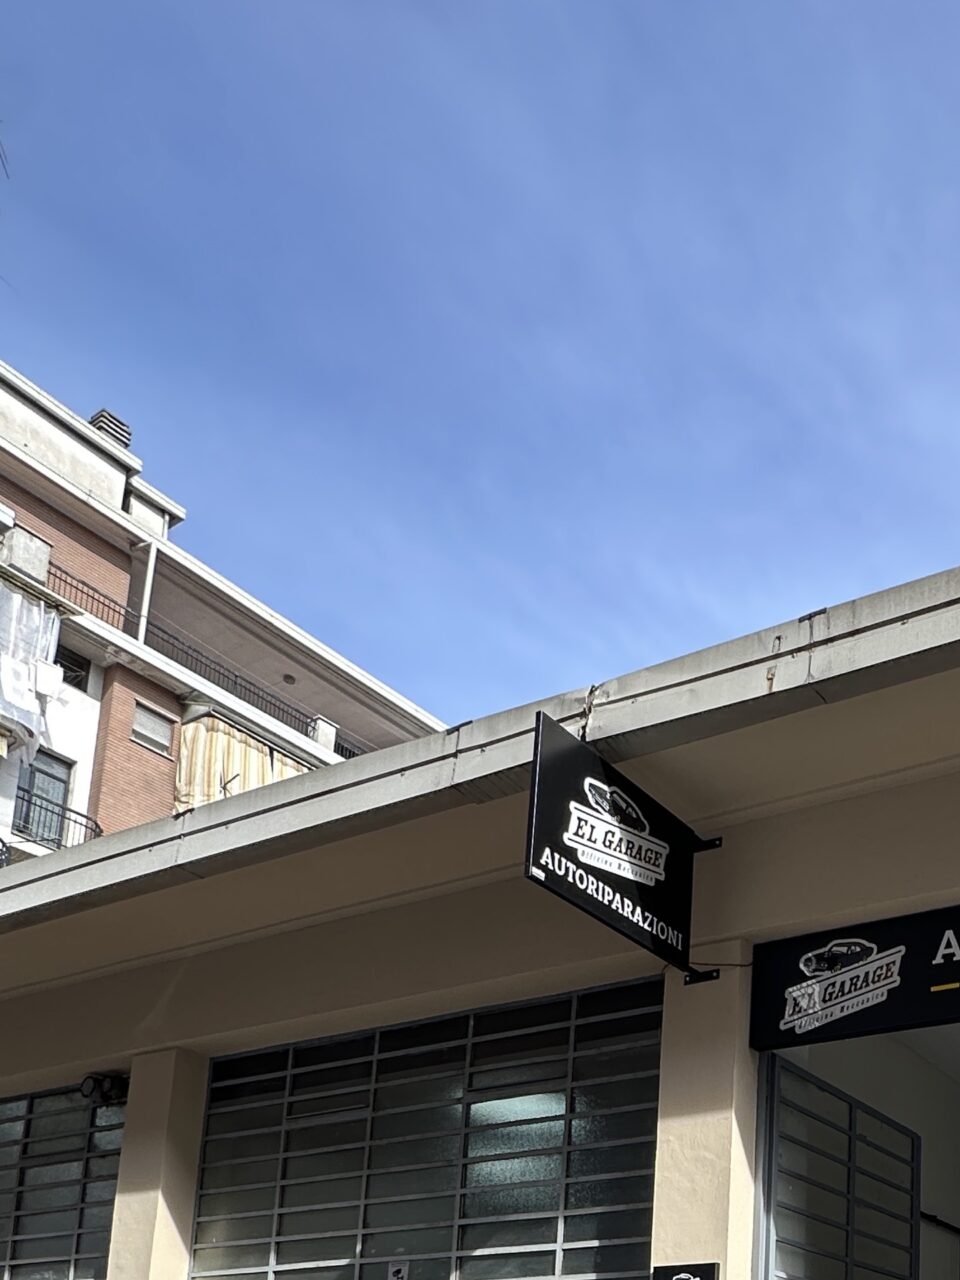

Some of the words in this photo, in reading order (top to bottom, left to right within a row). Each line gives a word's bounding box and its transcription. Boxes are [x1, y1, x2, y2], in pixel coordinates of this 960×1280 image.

[573, 816, 598, 844] EL
[602, 830, 664, 868] GARAGE
[540, 847, 682, 951] AUTORIPARAZIONI
[789, 992, 820, 1017] EL
[822, 960, 897, 1004] GARAGE
